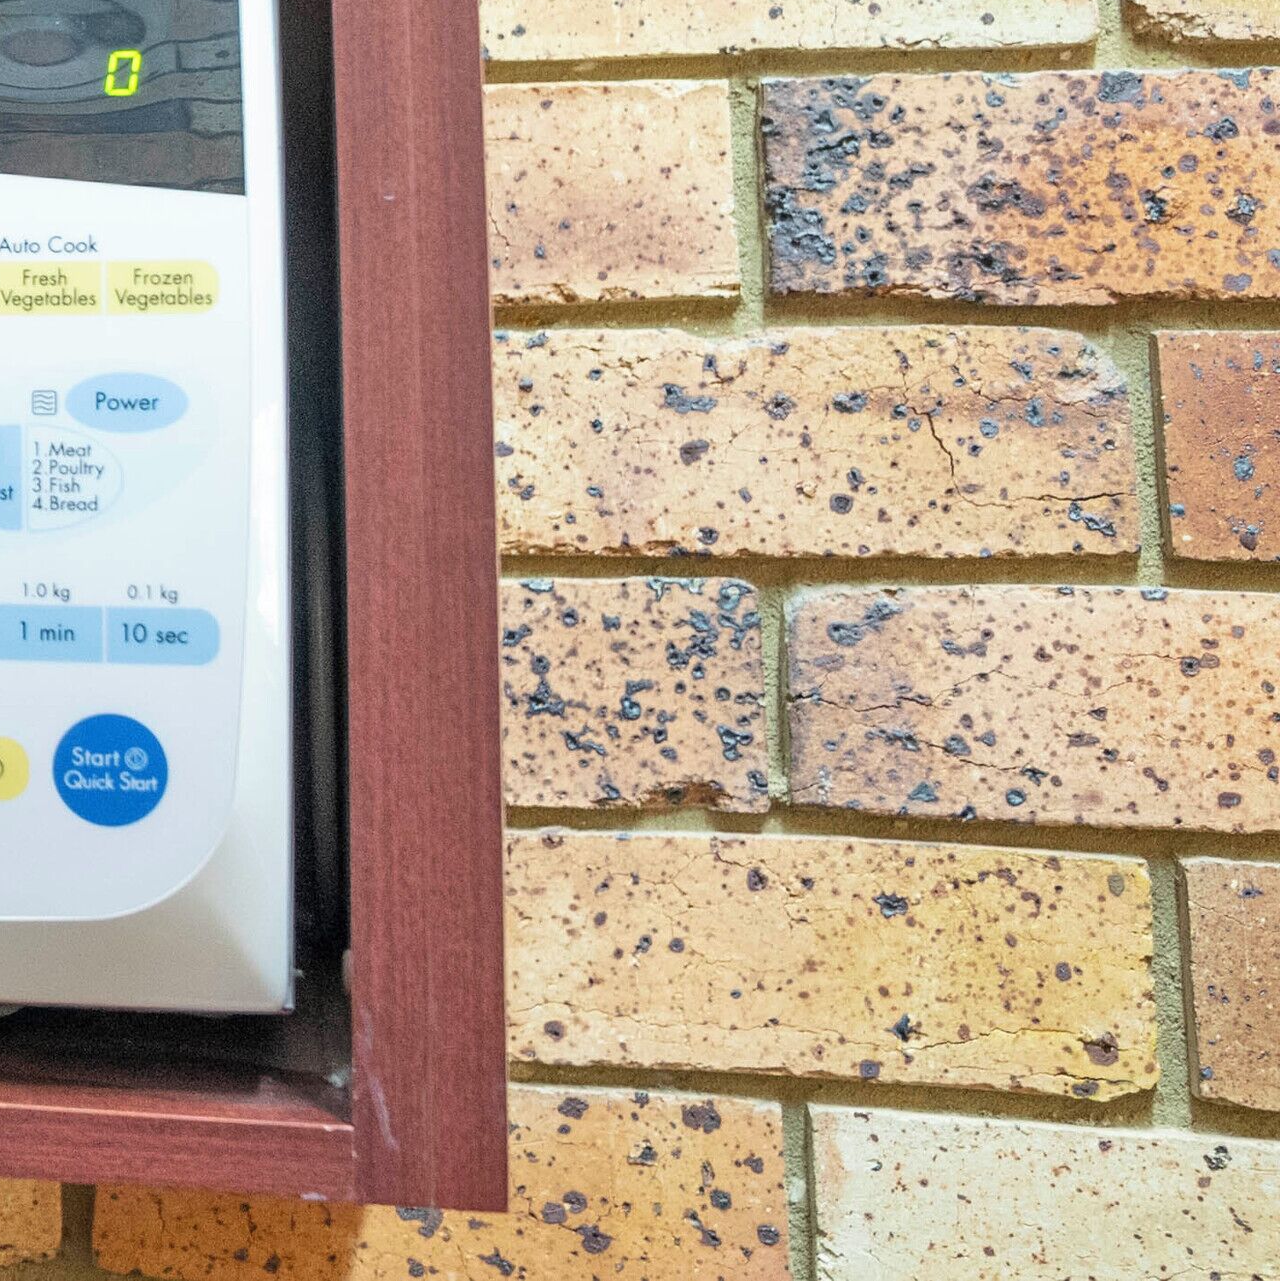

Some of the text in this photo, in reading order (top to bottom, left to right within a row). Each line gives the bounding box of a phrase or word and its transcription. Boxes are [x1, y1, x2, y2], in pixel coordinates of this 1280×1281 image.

[104, 49, 142, 96] 0
[47, 235, 99, 254] Cook
[21, 268, 68, 286] Fresh
[133, 267, 194, 286] Frozen
[0, 288, 97, 311] Vegetables
[114, 287, 214, 311] Vegetables
[94, 391, 159, 413] Power
[52, 584, 71, 603] kg
[160, 586, 179, 605] kg
[19, 621, 76, 642] 1 min
[122, 623, 189, 645] 10 sec
[72, 745, 121, 768] Start
[63, 769, 160, 793] Quick Start
